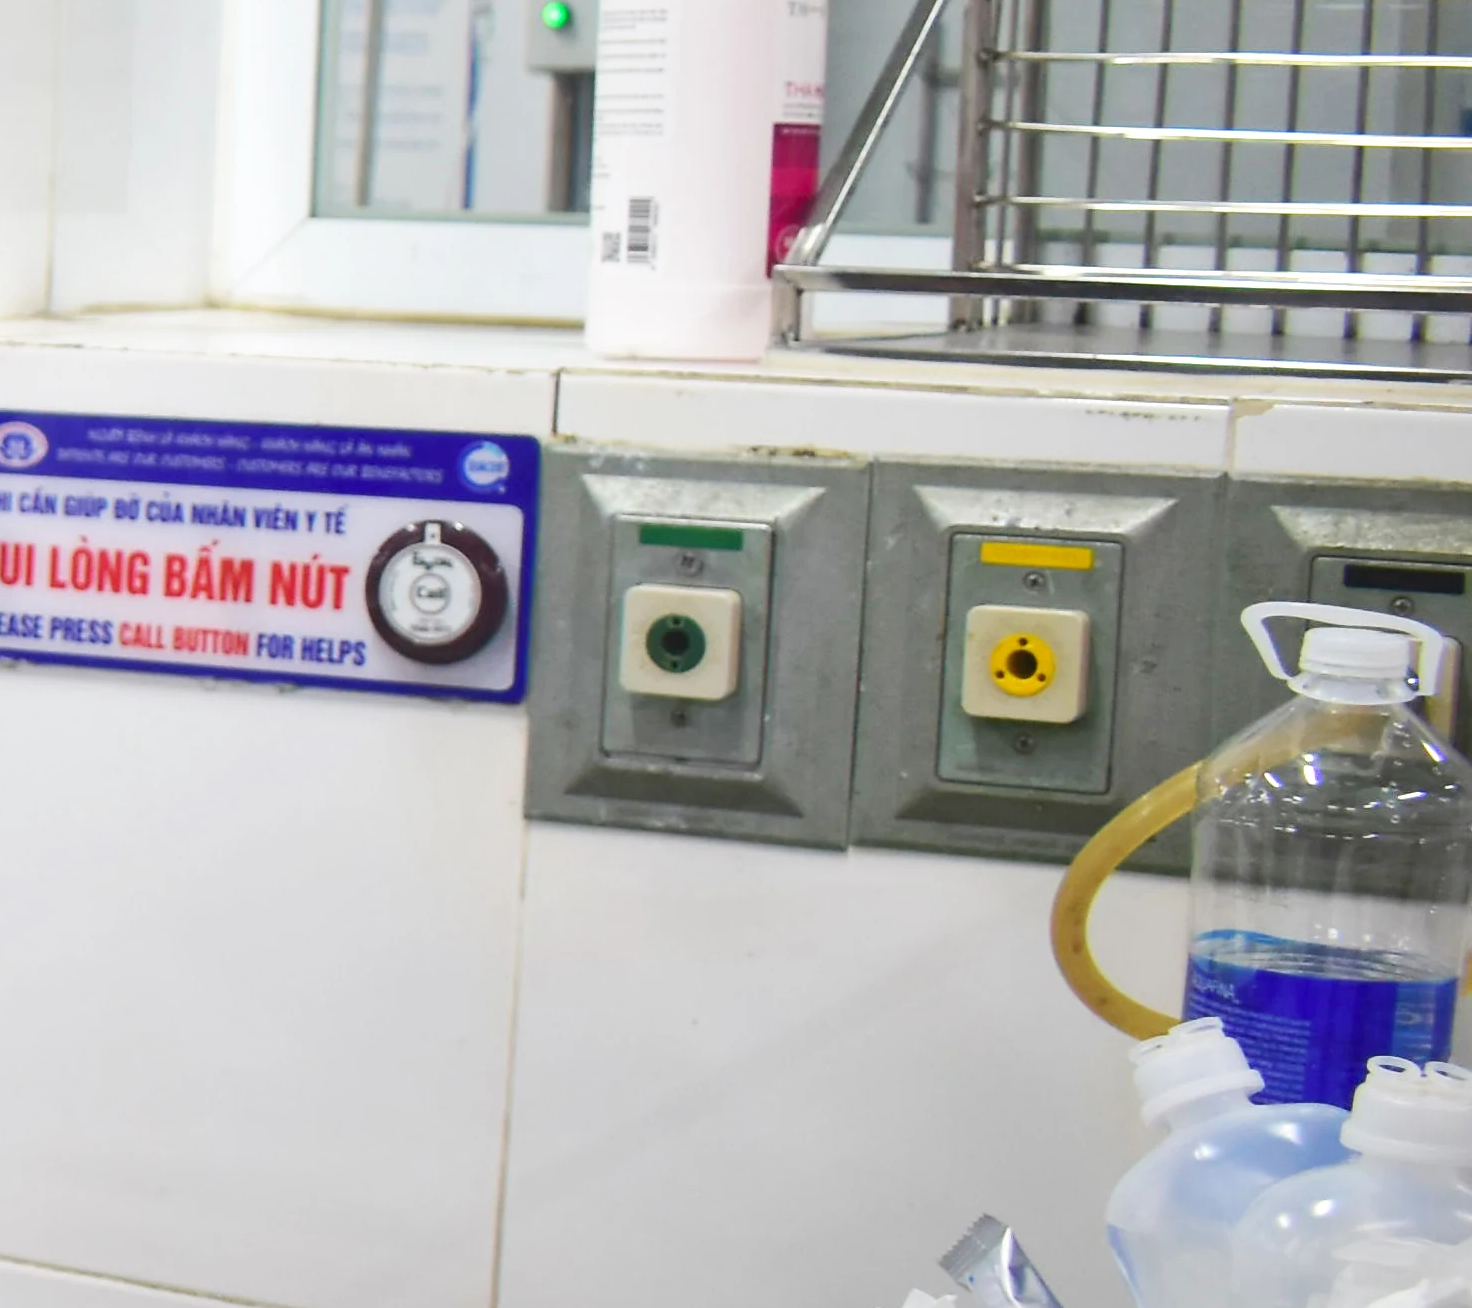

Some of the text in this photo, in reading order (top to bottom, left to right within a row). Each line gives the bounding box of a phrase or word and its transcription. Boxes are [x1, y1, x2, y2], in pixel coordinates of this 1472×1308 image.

[64, 489, 108, 518] GIÚP
[146, 490, 185, 523] CỦA
[190, 499, 247, 528] NHÂN
[252, 502, 299, 532] VIÊN
[304, 509, 317, 533] Y
[325, 502, 348, 535] TẾ
[49, 535, 151, 596] LÒNG
[163, 539, 255, 604] BẤM
[268, 553, 351, 611] NÚT
[49, 615, 114, 646] PRESS
[119, 619, 166, 650] CALL
[172, 623, 250, 657] BUTTON
[255, 631, 296, 661] FOR
[301, 635, 368, 667] HELPS
